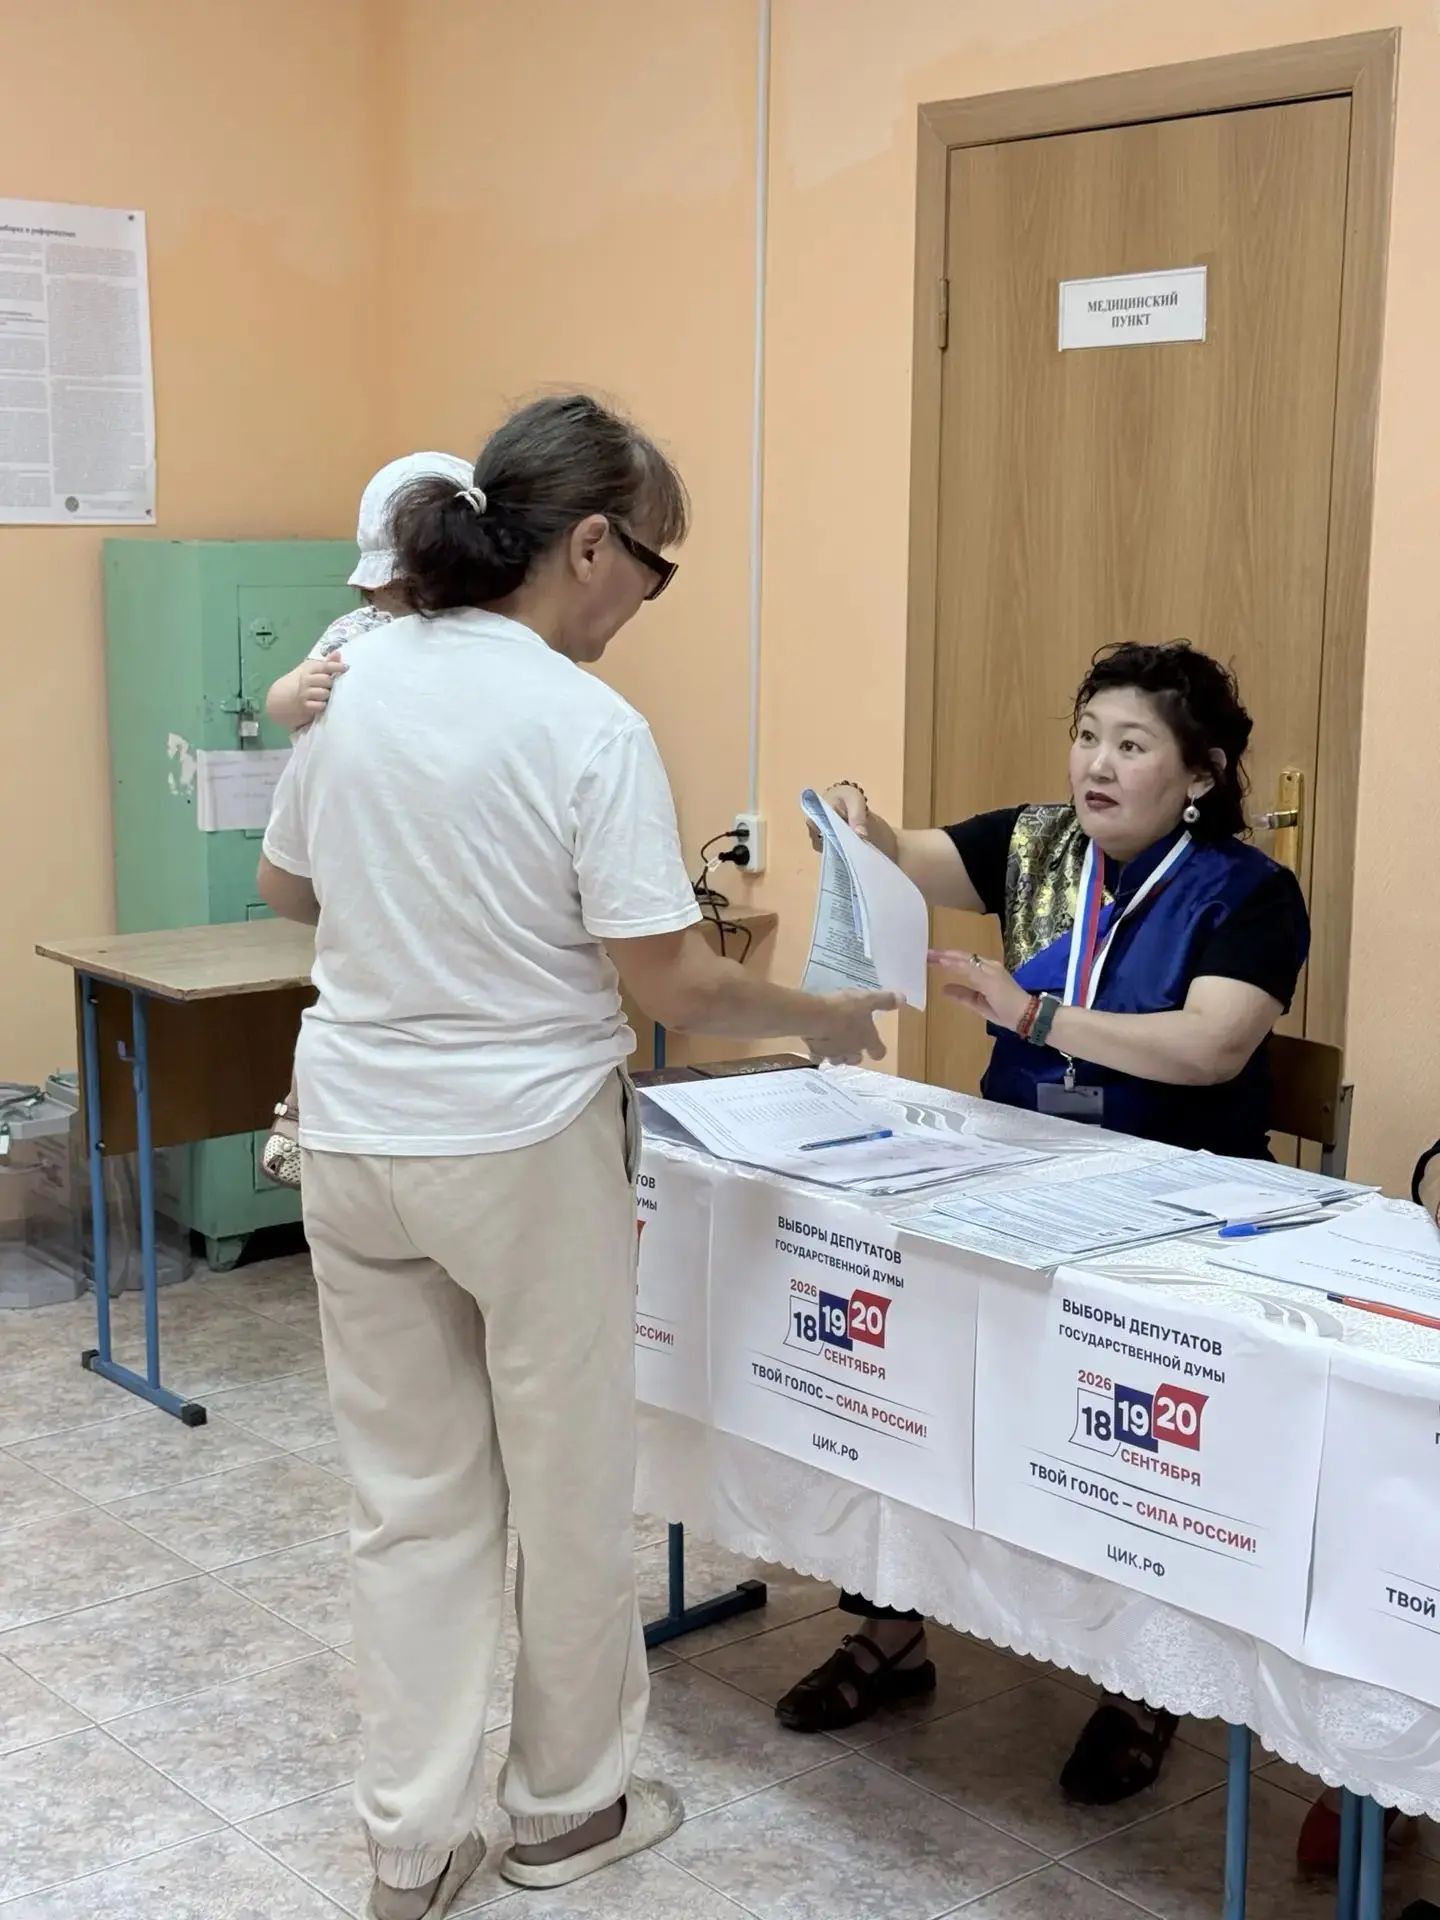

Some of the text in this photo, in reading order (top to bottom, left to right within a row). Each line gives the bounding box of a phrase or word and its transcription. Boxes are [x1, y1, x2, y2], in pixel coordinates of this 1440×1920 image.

[1087, 291, 1178, 313] МЕДИЦИНСКИЙ
[1111, 313, 1151, 328] ПУНКТ
[636, 1197, 657, 1211] УМЫ
[778, 1216, 902, 1264] ВЫБОРЫ ДЕПУТАТОВ
[775, 1239, 904, 1288] ГОСУДАРСТВЕННОЙ ДУМЫ
[790, 1279, 818, 1297] 2026
[793, 1301, 883, 1342] 18 19 20
[1062, 1298, 1222, 1356] ВЫБОРЫ ДЕПУТАТОВ
[824, 1348, 886, 1380] СЕНТЯБРЯ
[1059, 1324, 1226, 1384] ГОСУДАРСТВЕННОЙ ДУМЫ
[1078, 1370, 1112, 1391] 2026
[752, 1362, 783, 1384] ТВОЙ
[785, 1375, 823, 1399] ГОЛОС
[836, 1395, 869, 1417] СИЛА
[872, 1407, 927, 1438] РОССИИ!
[1082, 1397, 1197, 1441] 18 19 20
[812, 1434, 859, 1461] ЦИК.РФ
[1121, 1449, 1201, 1486] СЕНТЯБРЯ
[1029, 1462, 1067, 1488] ТВОЙ
[1071, 1478, 1119, 1505] ГОЛОС
[1136, 1501, 1178, 1527] СИЛА
[1183, 1517, 1257, 1553] РОССИИ!
[1107, 1544, 1165, 1577] ЦИК.РФ
[1386, 1587, 1435, 1618] ТВОЙ
